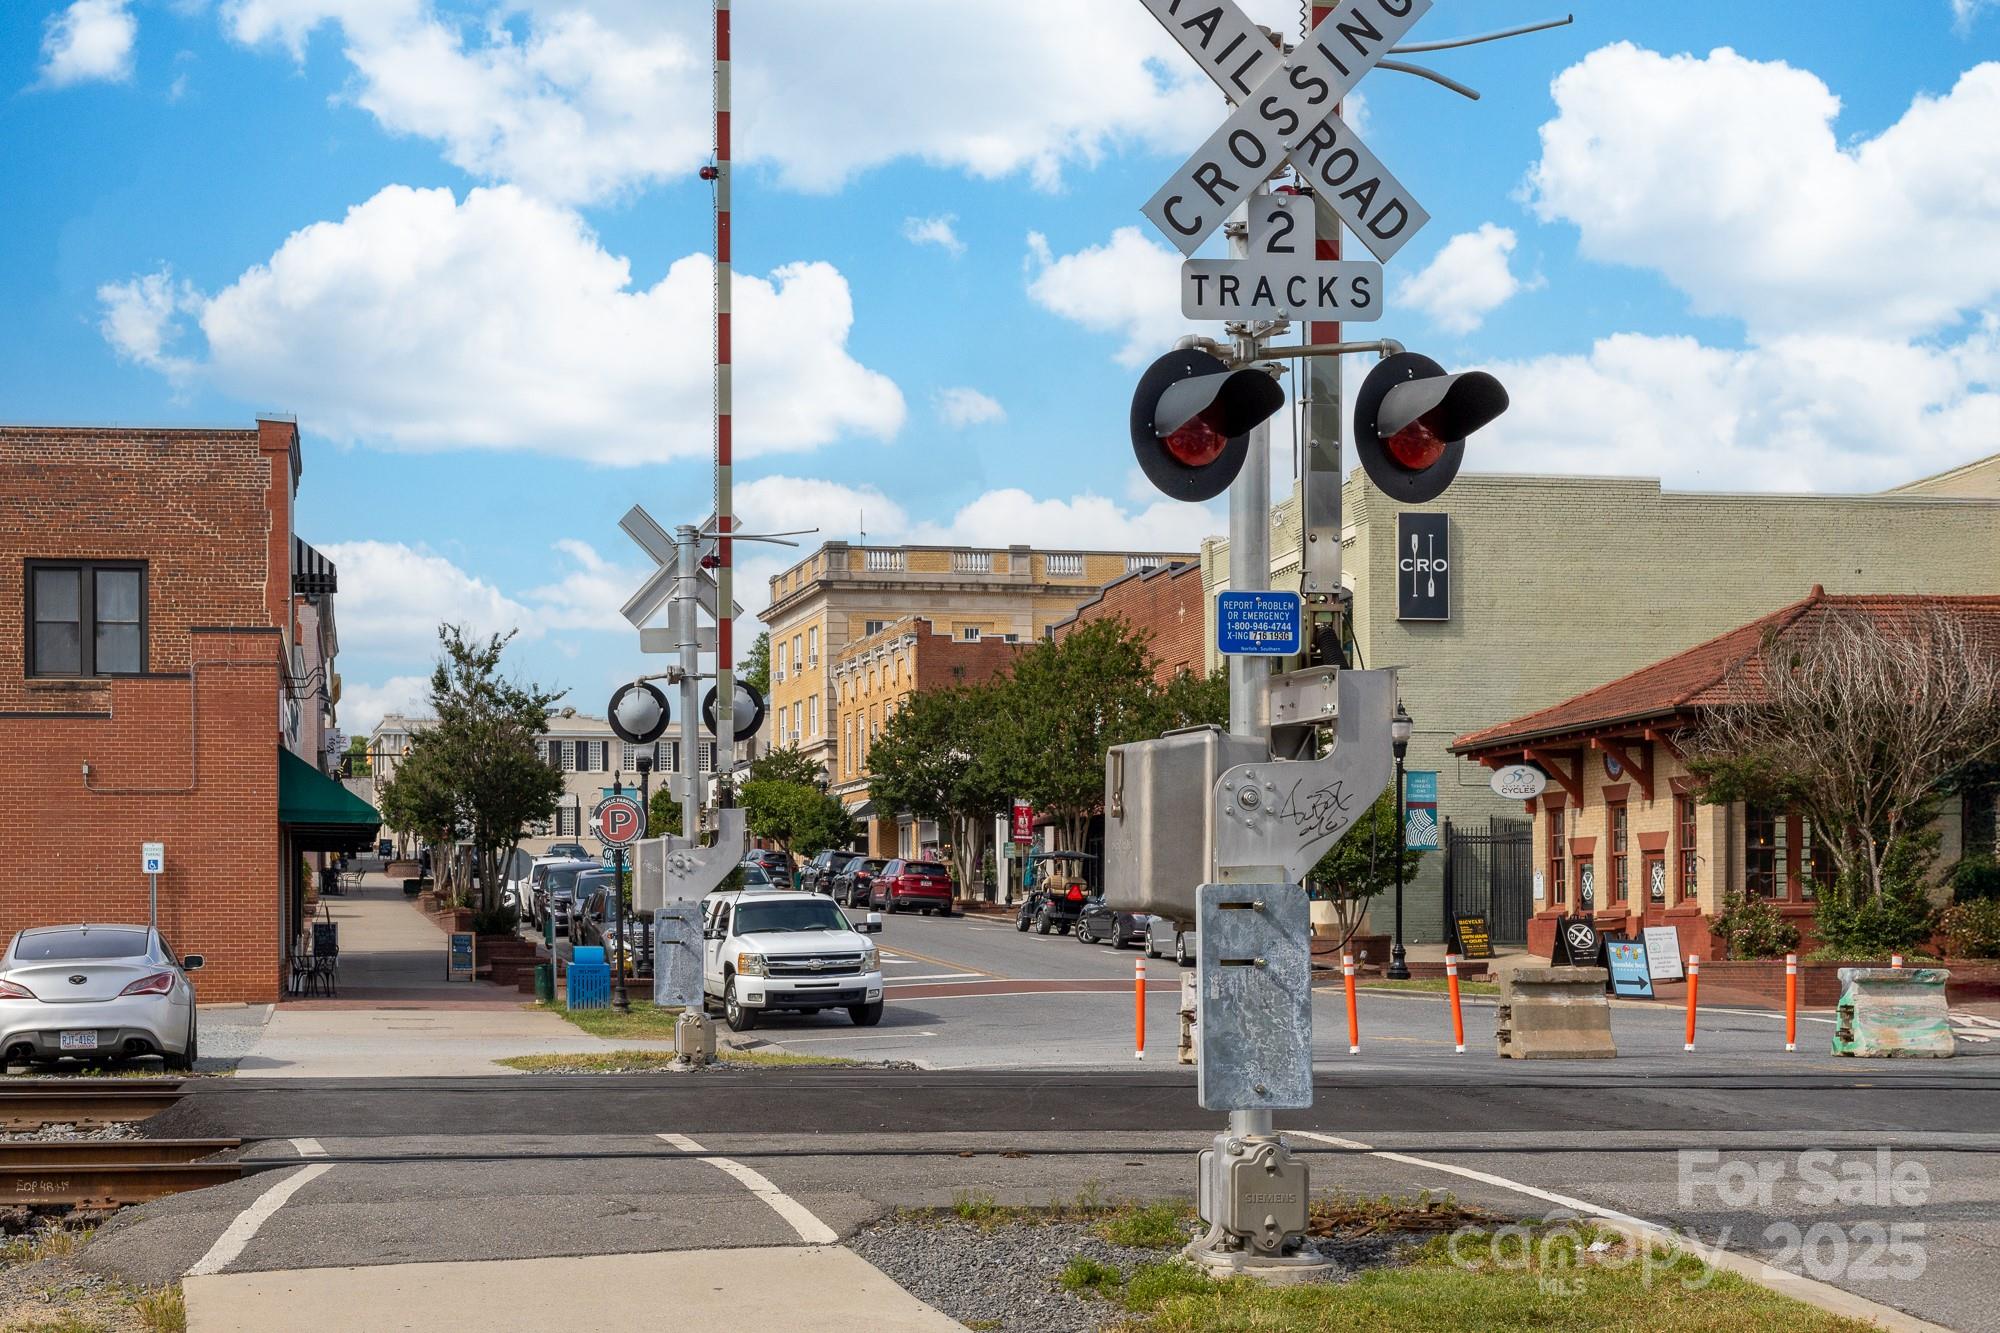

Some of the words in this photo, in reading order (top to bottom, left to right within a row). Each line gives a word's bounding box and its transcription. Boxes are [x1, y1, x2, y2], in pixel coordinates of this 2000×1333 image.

[1168, 0, 1263, 96] AIL
[1296, 121, 1409, 240] ROAD
[1266, 210, 1295, 254] 2
[1190, 274, 1371, 308] TRACKS
[1224, 601, 1253, 610] REPORT
[1258, 601, 1294, 610] PROBLEM
[1242, 612, 1290, 620] EMERGENCY
[1227, 622, 1291, 630] 1-800-946-4744
[1228, 632, 1248, 640] X-ING
[600, 798, 616, 809] PUBLIC
[616, 798, 637, 809] PARKING
[610, 810, 631, 834] P
[1245, 1193, 1296, 1203] SIEMENS
